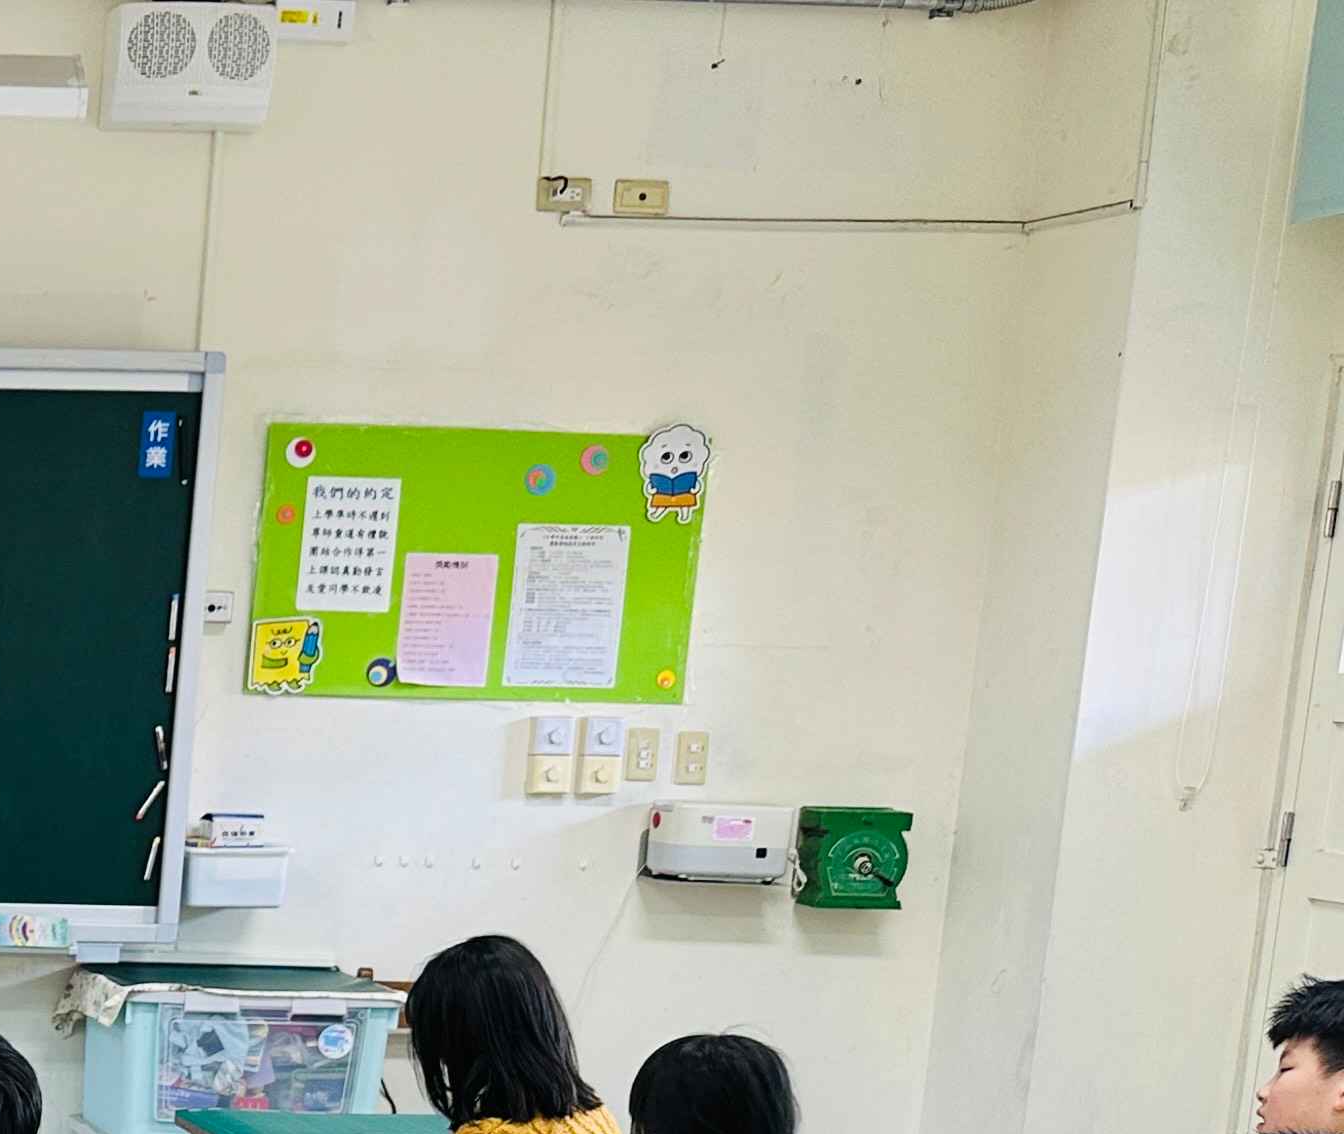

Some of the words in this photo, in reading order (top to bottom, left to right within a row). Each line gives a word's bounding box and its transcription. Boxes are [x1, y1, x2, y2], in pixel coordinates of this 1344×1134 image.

[145, 419, 171, 469] 作業
[313, 485, 395, 501] 我們的約定
